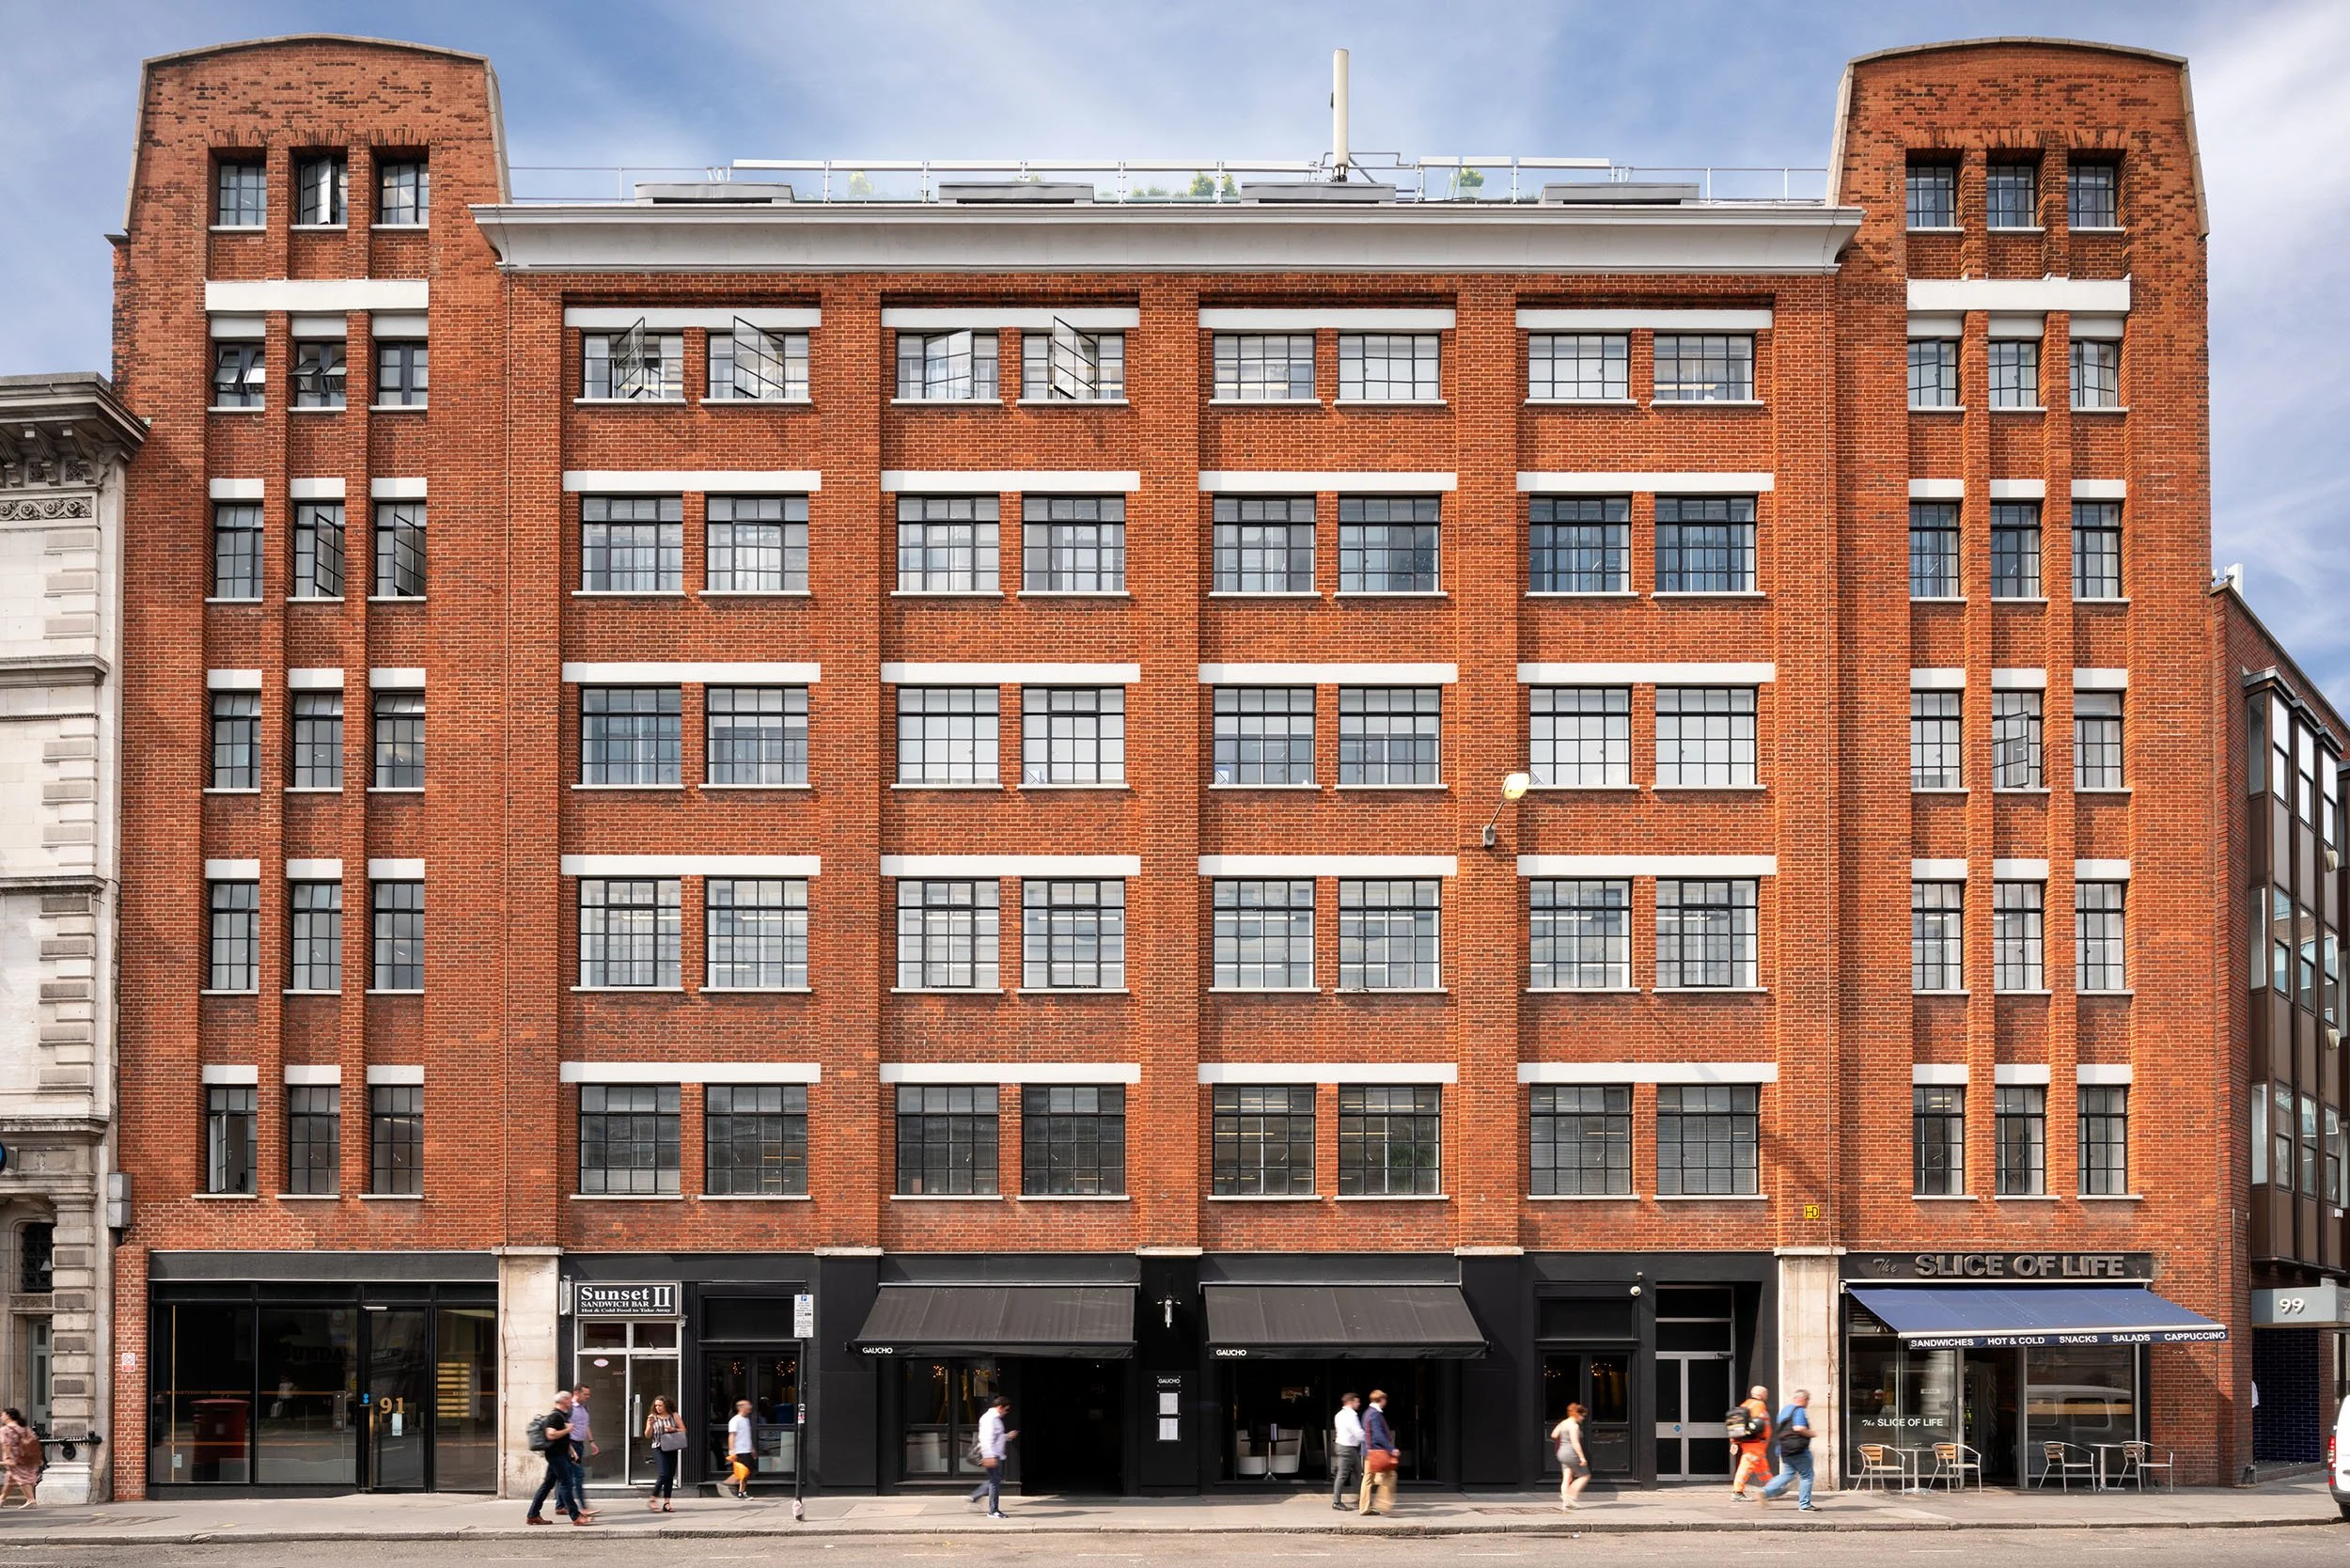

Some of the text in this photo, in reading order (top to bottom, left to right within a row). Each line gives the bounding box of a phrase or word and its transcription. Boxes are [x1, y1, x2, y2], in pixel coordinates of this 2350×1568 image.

[1872, 1254, 2124, 1277] The SLICE OF LIFE
[581, 1286, 650, 1301] Sunset
[2279, 1297, 2305, 1315] 99
[1910, 1338, 1974, 1347] SANDWICHES
[2009, 1337, 2017, 1345] &
[2018, 1336, 2045, 1344] COLD
[2059, 1335, 2098, 1343] SNACKS
[2112, 1333, 2151, 1342] SALADS
[2164, 1331, 2226, 1341] CAPPUCCINO
[380, 1397, 404, 1414] 91
